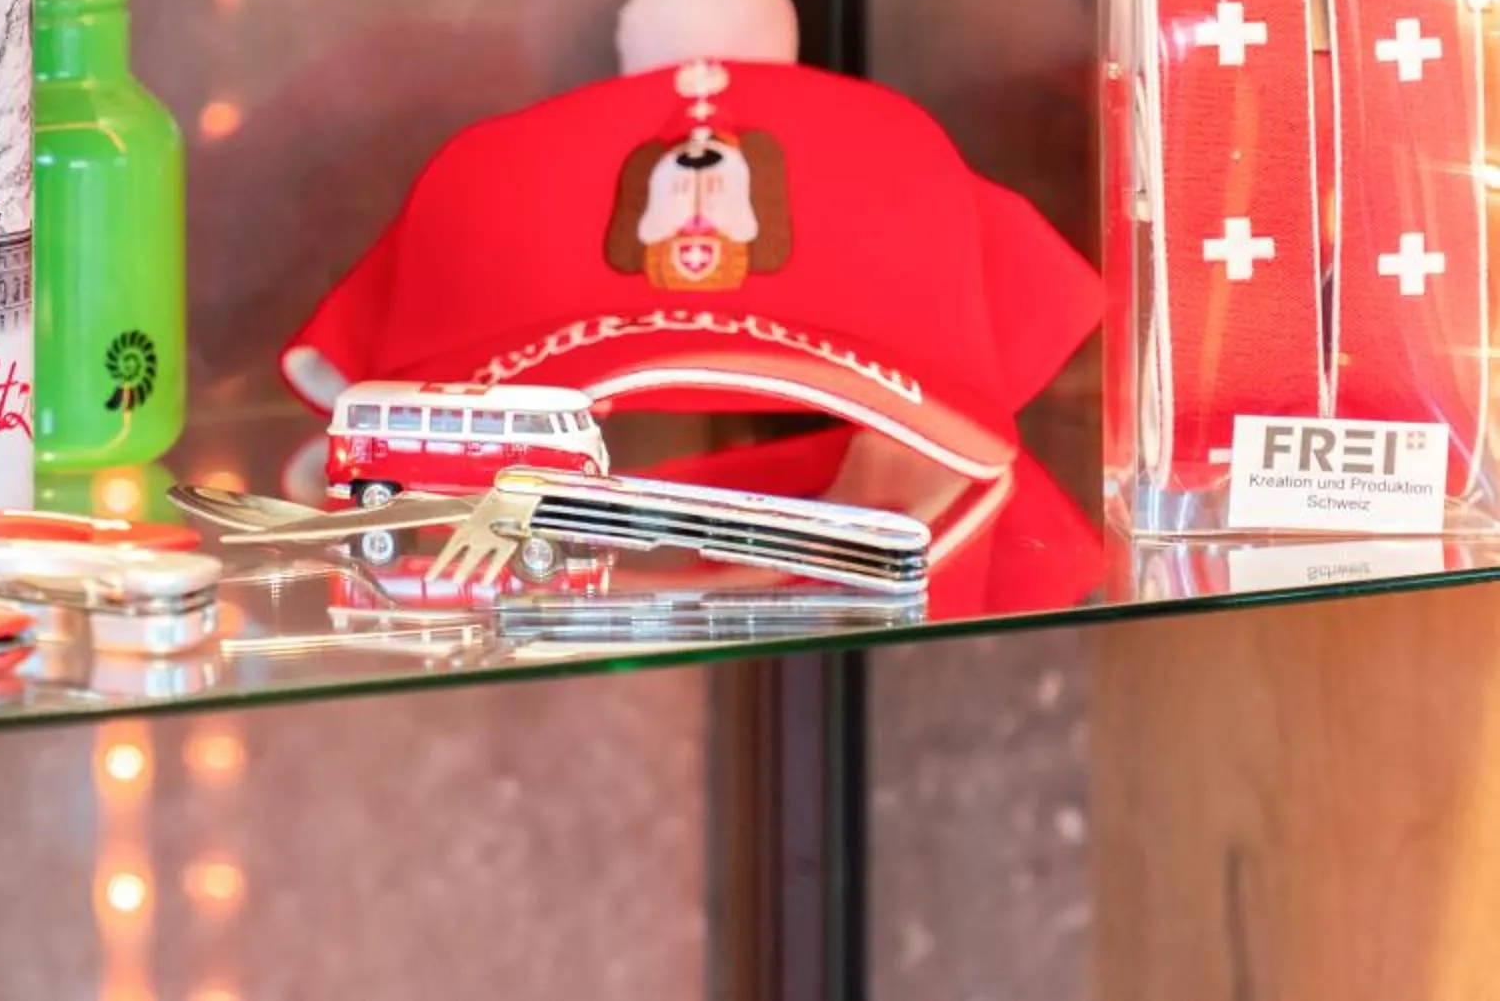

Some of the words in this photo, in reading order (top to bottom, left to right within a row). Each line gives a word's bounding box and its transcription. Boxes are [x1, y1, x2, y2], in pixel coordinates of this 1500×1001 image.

[1262, 425, 1398, 475] FREI
[1249, 474, 1312, 488] Kreation
[1317, 478, 1345, 491] und
[1350, 478, 1433, 496] Produktion
[1307, 494, 1371, 511] Schweiz
